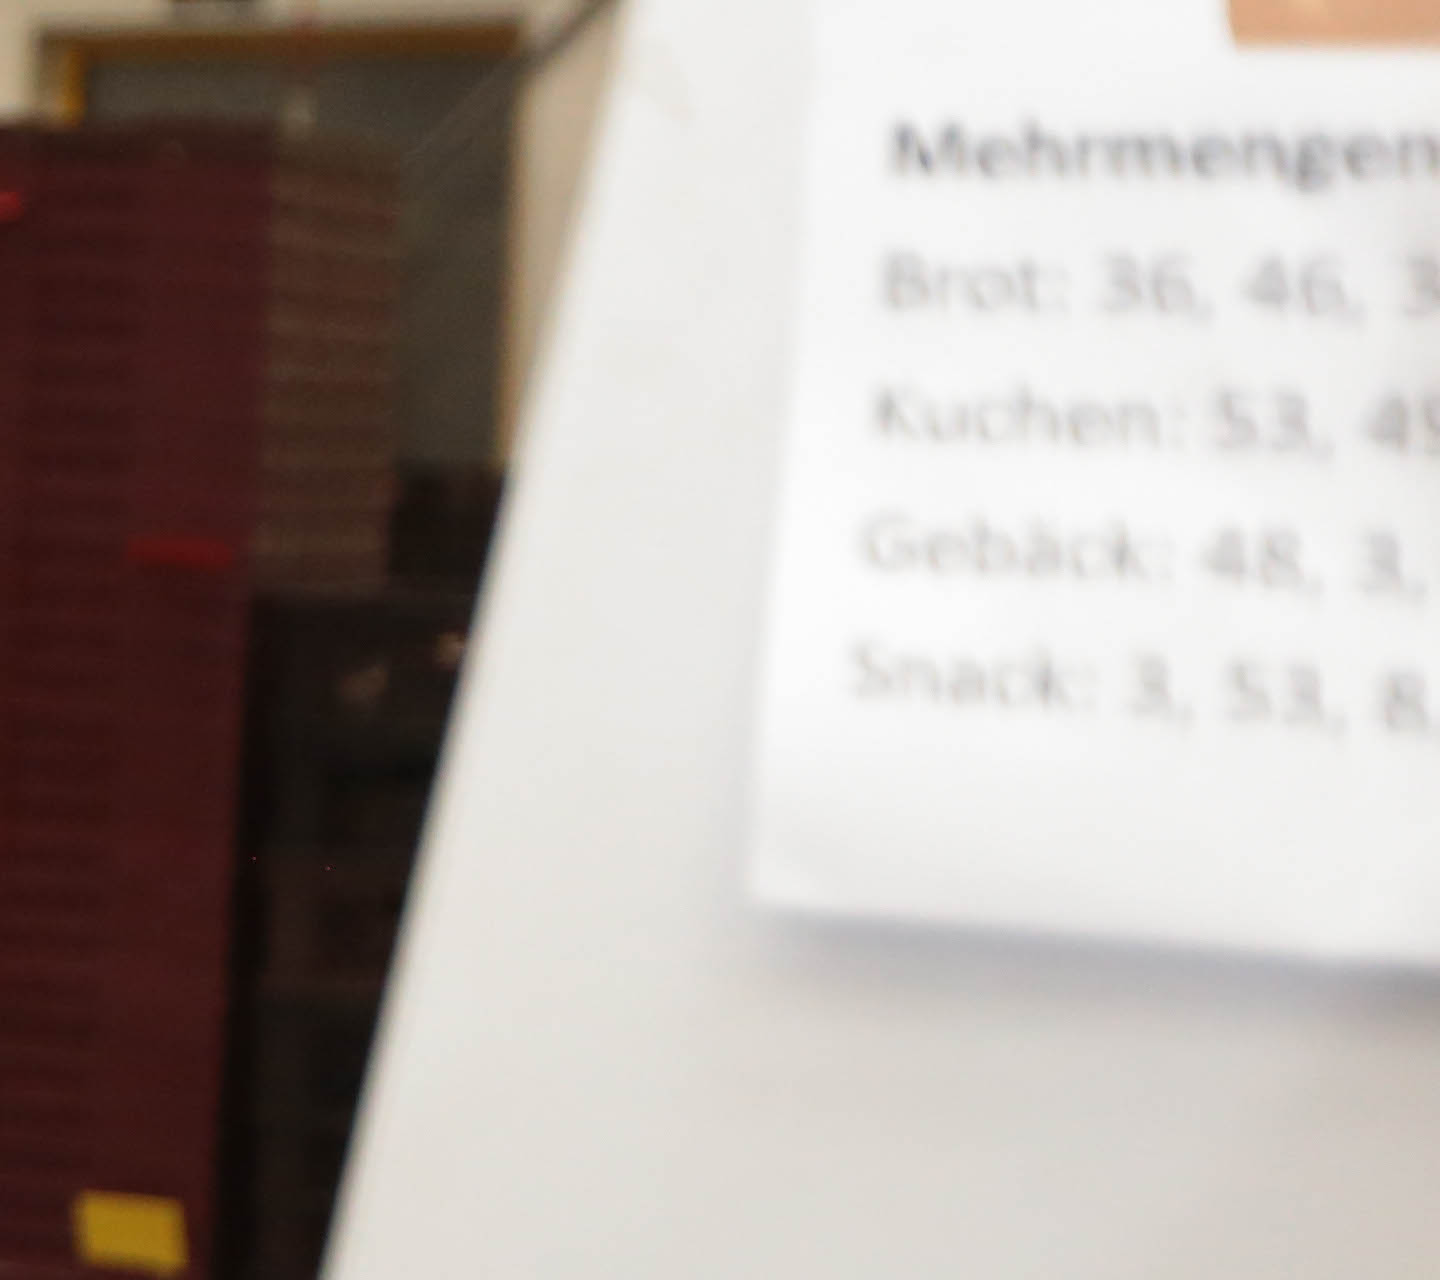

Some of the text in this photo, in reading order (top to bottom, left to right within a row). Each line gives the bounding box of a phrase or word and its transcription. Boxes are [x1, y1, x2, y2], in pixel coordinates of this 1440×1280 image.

[892, 119, 1440, 196] Mehrmengen
[883, 253, 1068, 313] Brot:
[1101, 253, 1212, 324] 36,
[1243, 253, 1364, 324] 46,
[873, 384, 1185, 450] Kuchen:
[1216, 387, 1333, 460] 53,
[859, 509, 1426, 606] Gebäck: 48, 3,
[848, 636, 1095, 710] Snack:
[1130, 651, 1195, 730] 3,
[1227, 658, 1348, 743] 53,
